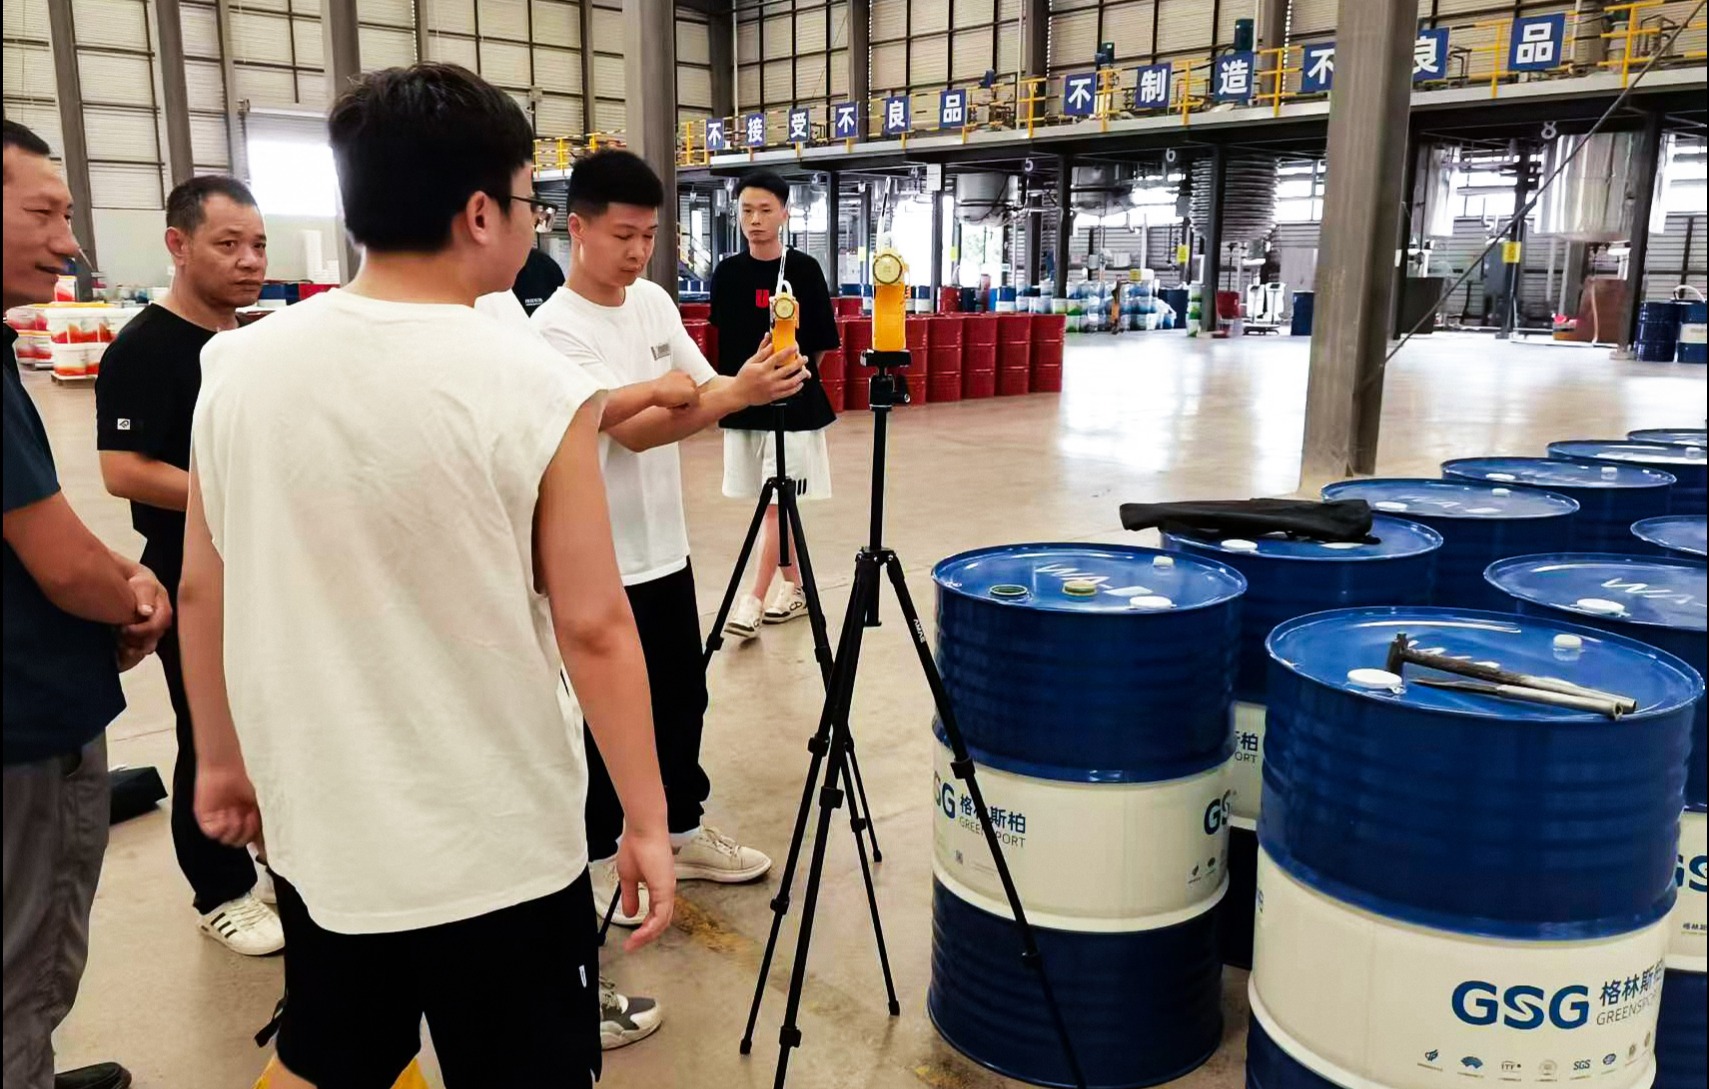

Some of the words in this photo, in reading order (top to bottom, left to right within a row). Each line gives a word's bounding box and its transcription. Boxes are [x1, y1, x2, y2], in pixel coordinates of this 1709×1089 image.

[1165, 148, 1176, 162] 6
[1024, 157, 1034, 172] 5
[959, 793, 1026, 834] 格斯柏
[1451, 980, 1590, 1030] GSG
[1573, 1059, 1591, 1071] SGS
